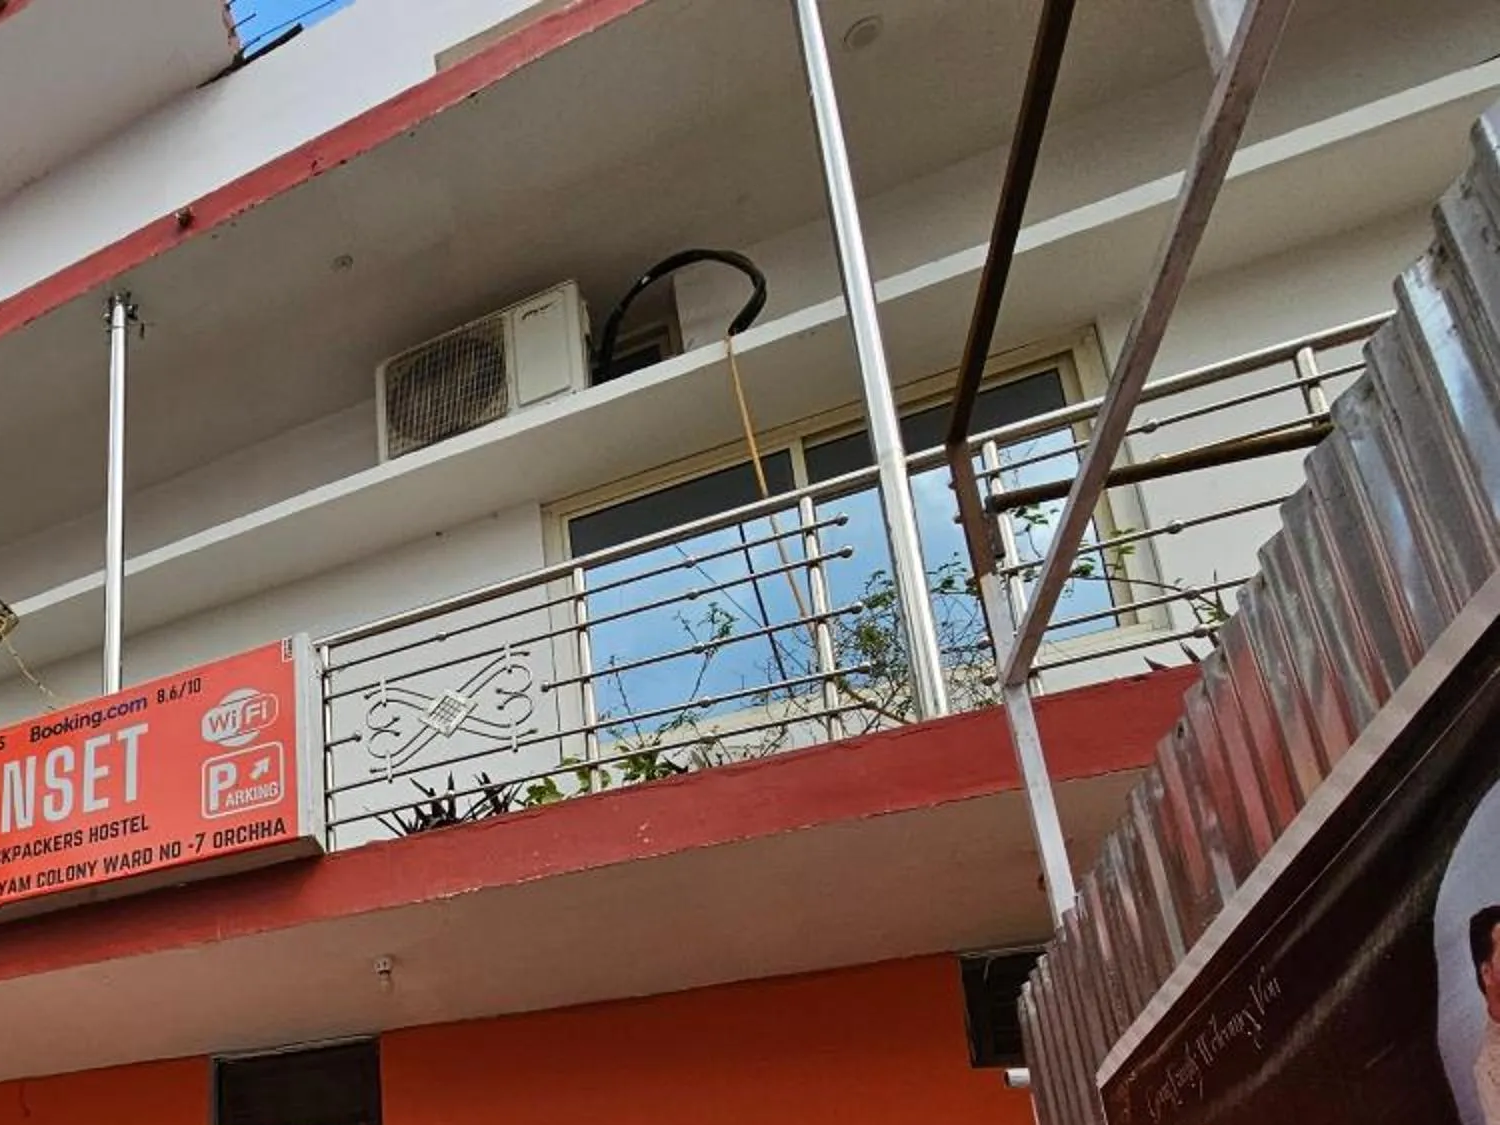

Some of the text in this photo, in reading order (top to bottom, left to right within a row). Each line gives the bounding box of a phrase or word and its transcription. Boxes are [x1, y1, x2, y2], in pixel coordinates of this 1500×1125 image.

[29, 695, 148, 743] Booking.com
[88, 814, 150, 842] HOSTEL
[36, 859, 100, 889] COLONY
[103, 847, 153, 875] WARD
[159, 840, 182, 860] NO
[213, 817, 287, 849] ORCHHA
